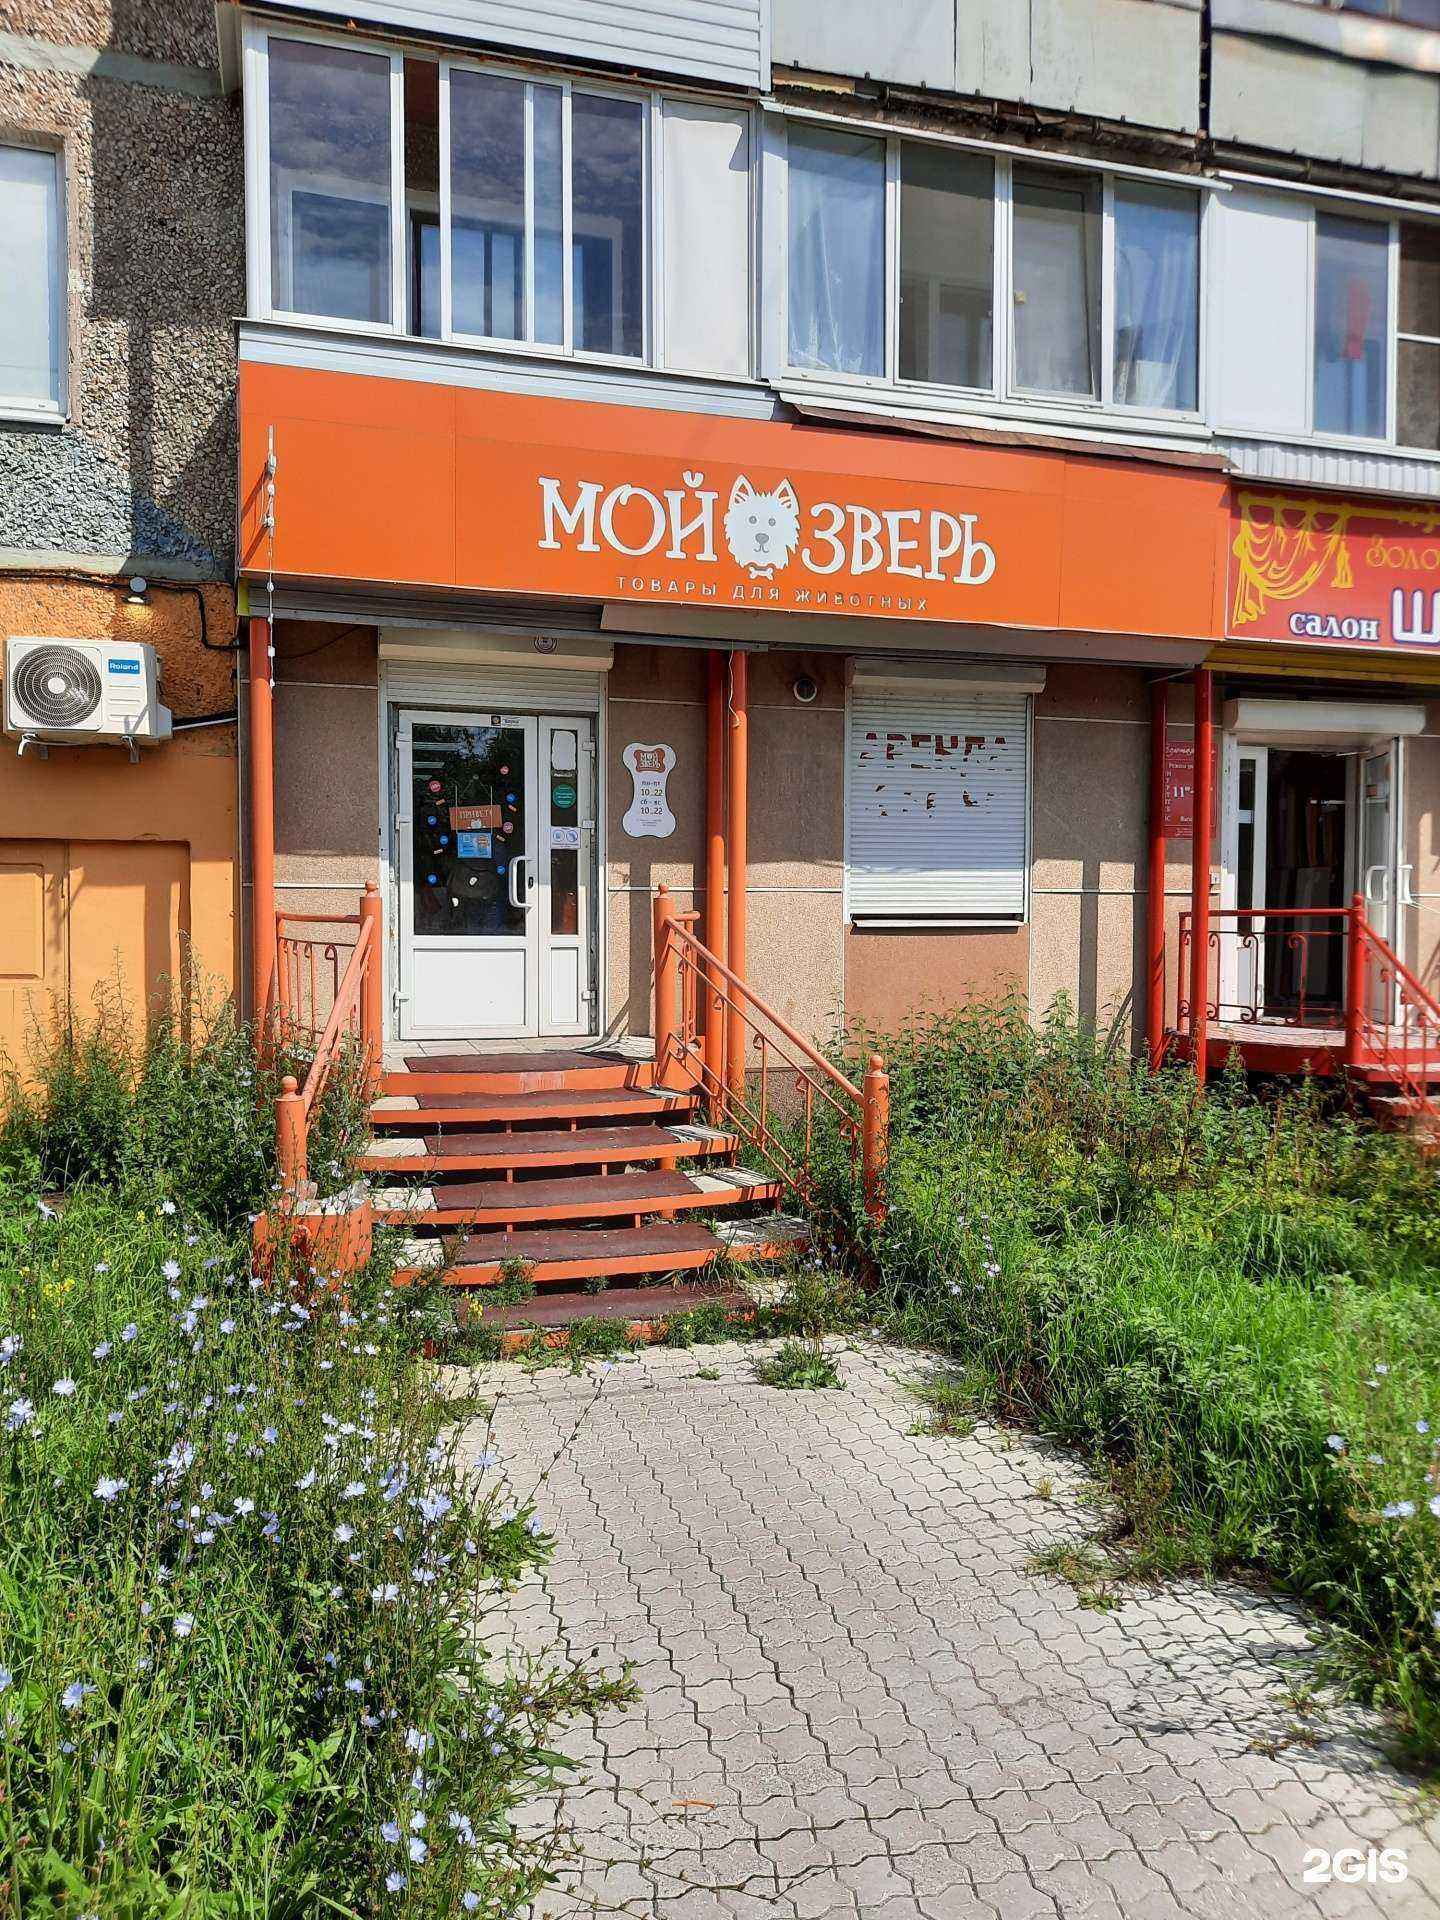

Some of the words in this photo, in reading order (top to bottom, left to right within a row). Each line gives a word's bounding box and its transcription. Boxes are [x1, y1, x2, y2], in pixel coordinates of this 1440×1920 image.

[538, 470, 719, 562] МОЙ
[801, 502, 997, 585] ЗВЕРЬ
[616, 576, 717, 596] ТОВАРЫ
[733, 584, 780, 601] ДЛЯ
[794, 589, 927, 611] ЖИВОТНЫХ
[1289, 612, 1380, 641] салон
[109, 662, 139, 671] Roland
